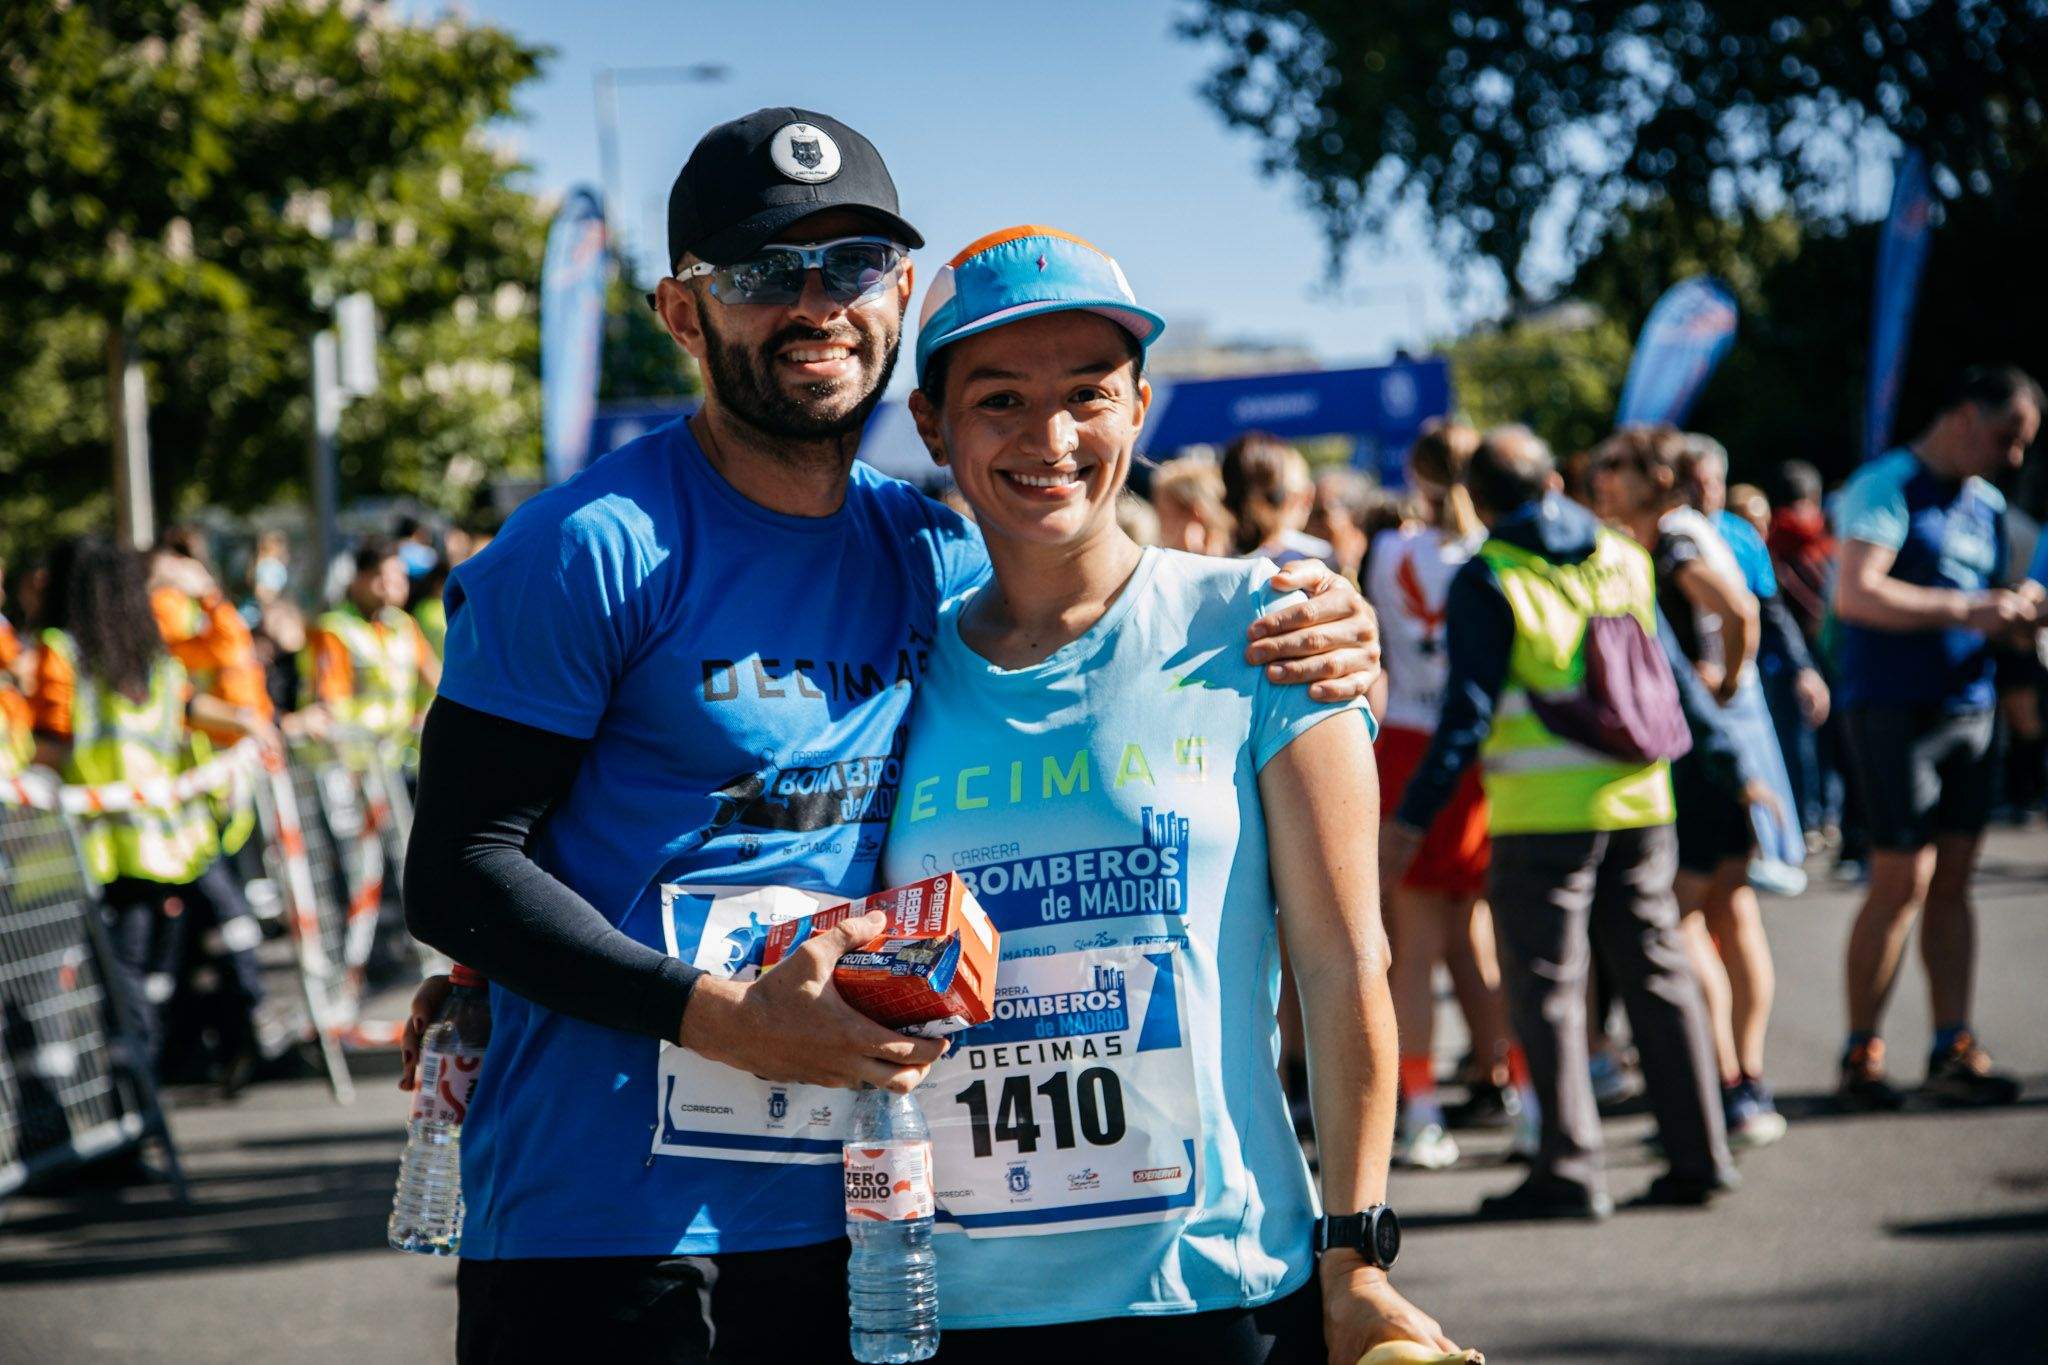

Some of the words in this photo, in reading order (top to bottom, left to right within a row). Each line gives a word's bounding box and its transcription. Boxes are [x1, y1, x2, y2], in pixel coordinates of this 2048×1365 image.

[895, 736, 1208, 823] ECIMAS
[952, 841, 1020, 867] CARRERA
[961, 846, 1180, 899] BOMBEROS
[904, 887, 924, 936] BEBIDA
[1041, 888, 1071, 922] de
[1079, 878, 1182, 917] MADRID
[995, 985, 1030, 998] RRERA
[1034, 1017, 1056, 1039] de
[1060, 1009, 1124, 1036] MADRID
[969, 1035, 1123, 1071] DECIMAS
[955, 1066, 1126, 1159] 1410
[845, 1186, 891, 1200] SODIO
[846, 1172, 889, 1186] ZERO
